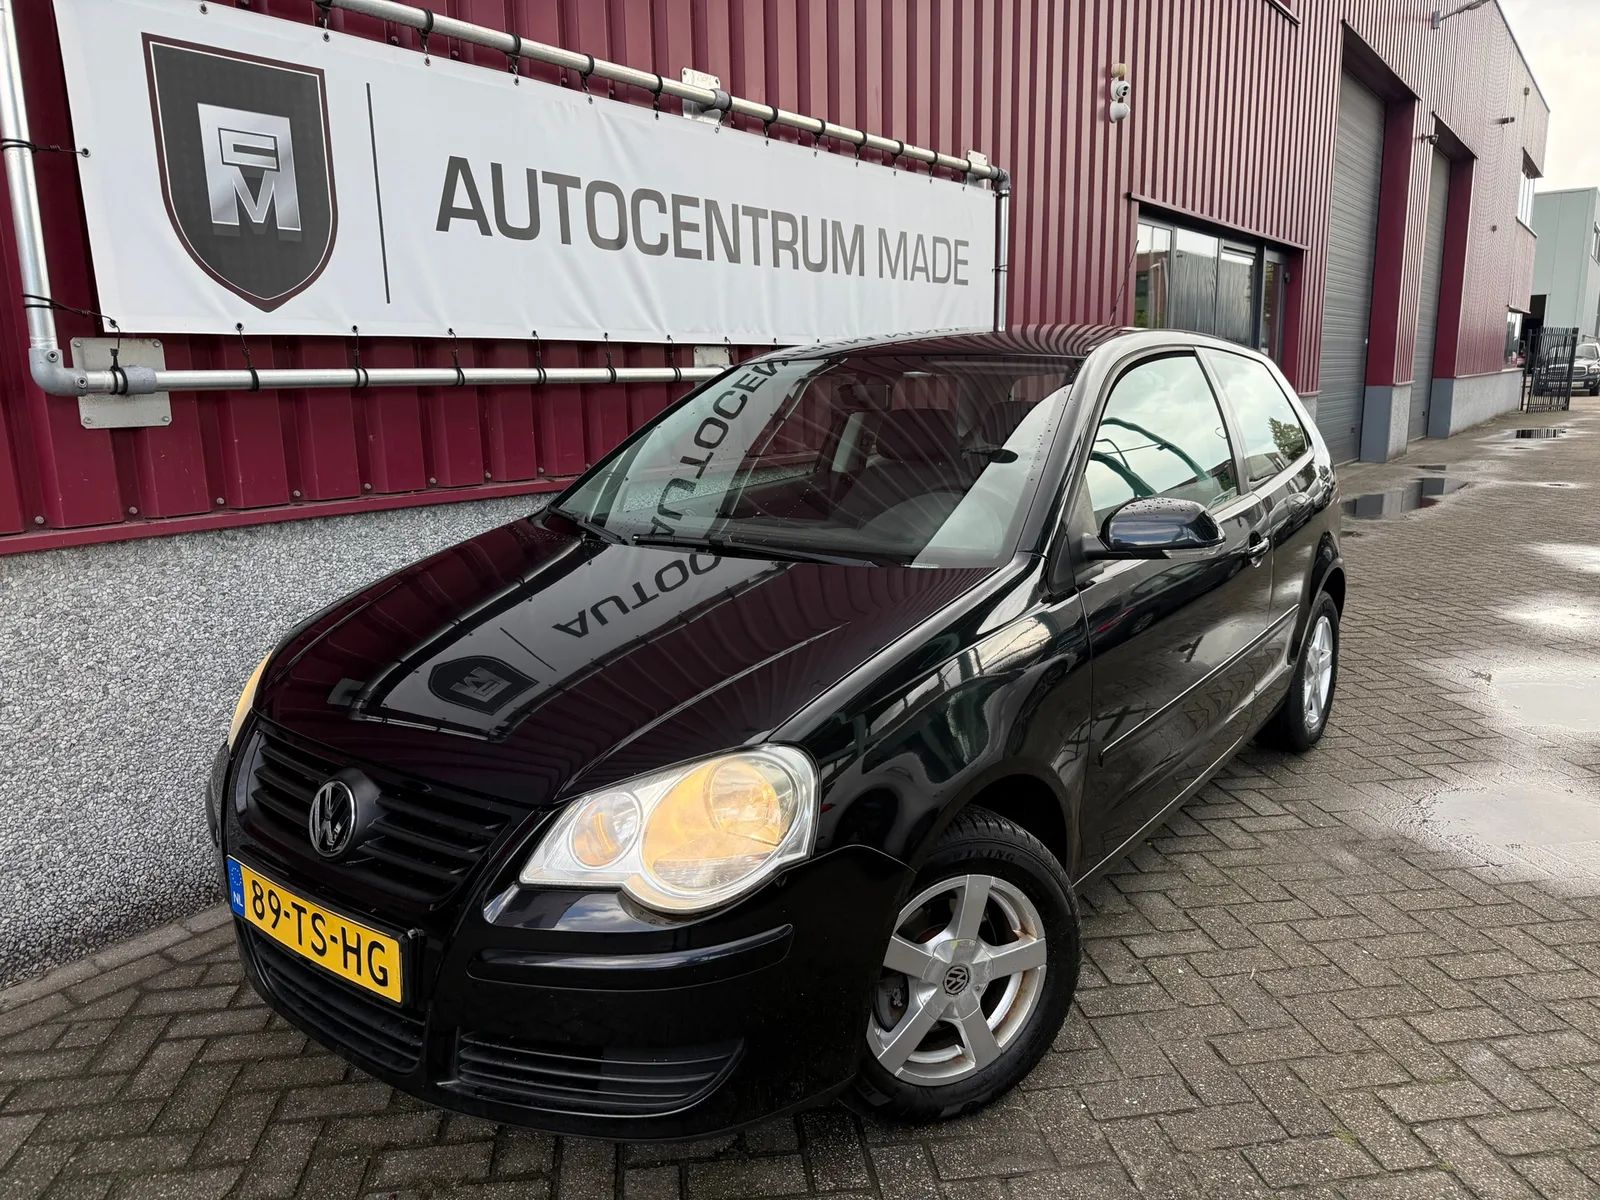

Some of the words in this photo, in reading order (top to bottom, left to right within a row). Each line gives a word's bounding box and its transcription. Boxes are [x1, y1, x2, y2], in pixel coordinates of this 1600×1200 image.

[435, 155, 865, 277] AUTOCENTRUM
[878, 227, 970, 286] MADE
[232, 891, 244, 908] NL
[251, 879, 389, 988] 89-TS-HG
